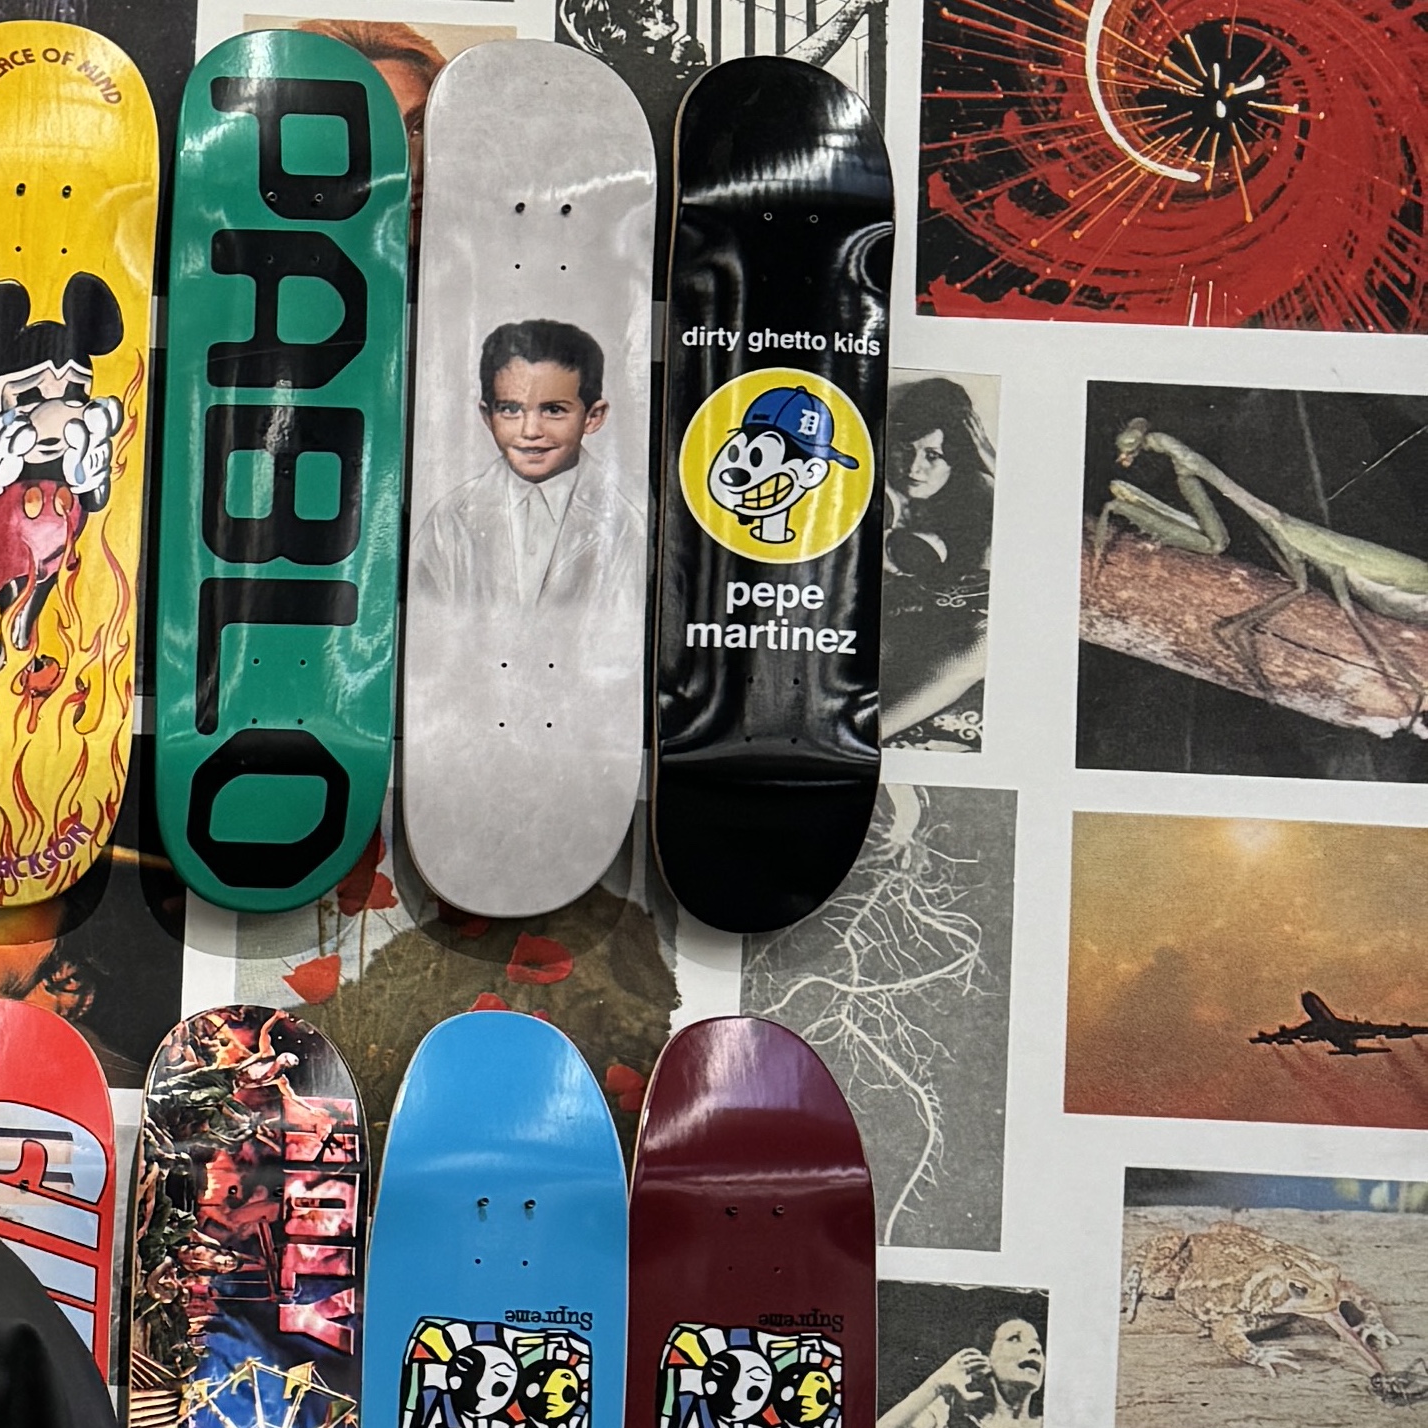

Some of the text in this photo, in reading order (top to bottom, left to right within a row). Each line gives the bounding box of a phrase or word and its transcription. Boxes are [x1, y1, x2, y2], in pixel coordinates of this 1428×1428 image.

[42, 48, 75, 65] OF
[77, 60, 122, 104] MIND
[682, 326, 881, 356] dirty ghetto kids
[187, 76, 372, 888] PABLO
[727, 582, 824, 616] pepe
[686, 619, 857, 654] martinez
[279, 1095, 360, 1356] HOLY
[505, 1306, 592, 1331] Supreme
